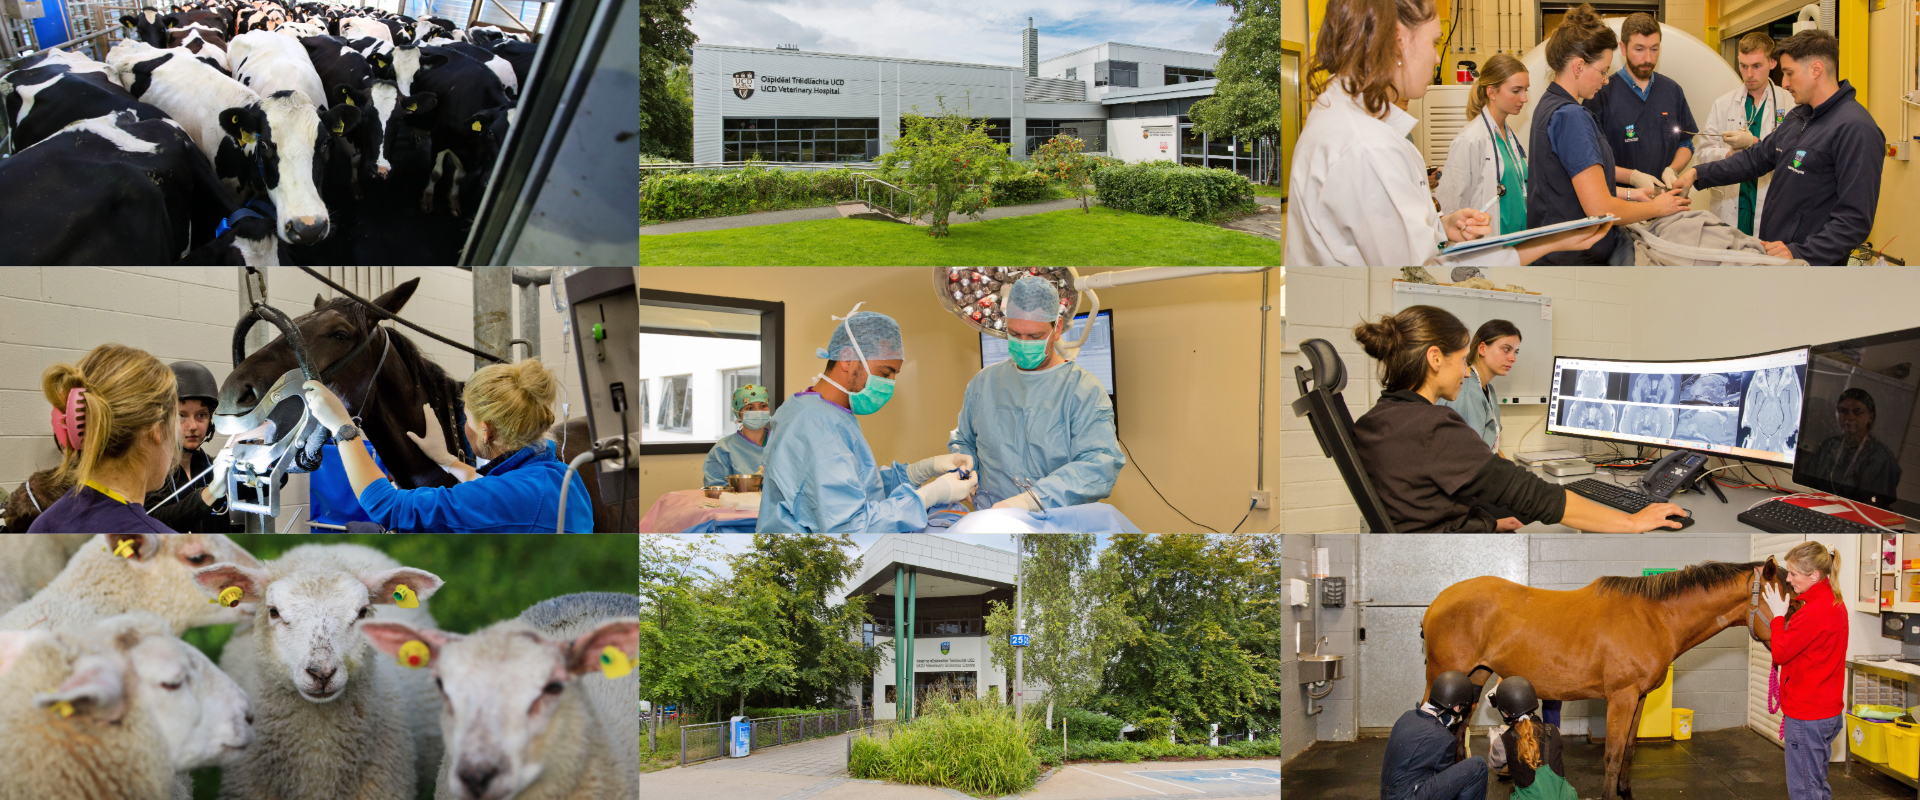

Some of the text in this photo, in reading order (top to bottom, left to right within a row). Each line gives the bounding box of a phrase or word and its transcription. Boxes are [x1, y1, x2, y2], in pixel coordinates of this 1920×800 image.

[761, 76, 790, 84] Ospidéal
[778, 86, 812, 95] Veterinary
[814, 87, 840, 95] Hospital
[1012, 635, 1023, 644] 25
